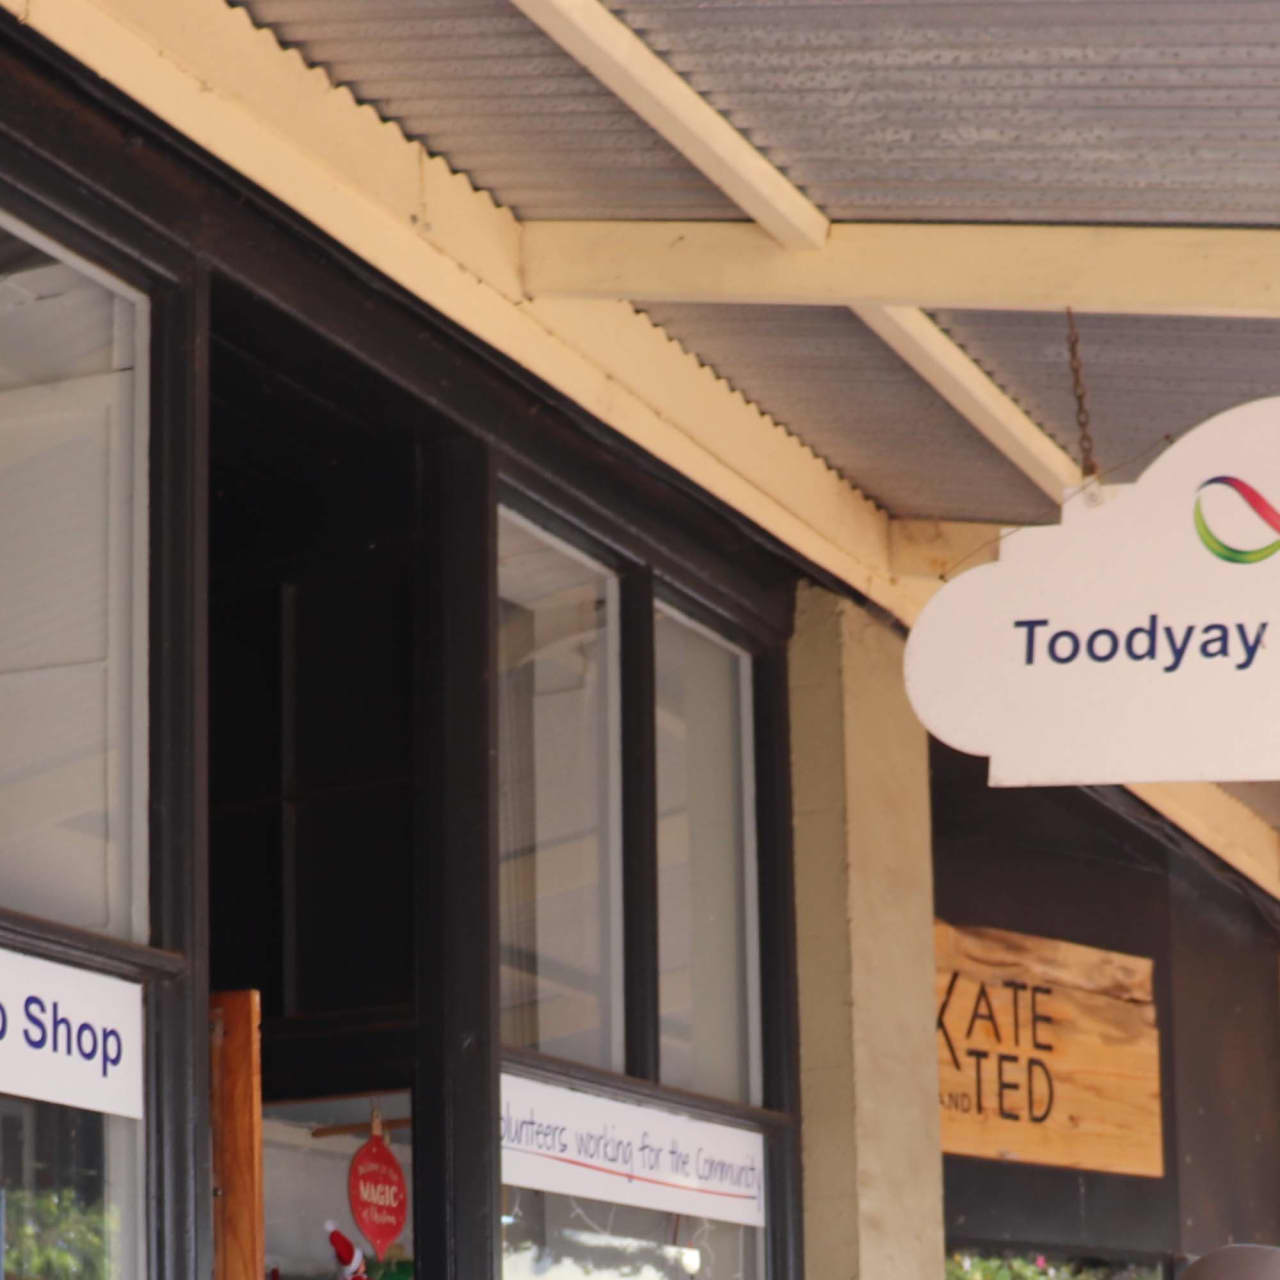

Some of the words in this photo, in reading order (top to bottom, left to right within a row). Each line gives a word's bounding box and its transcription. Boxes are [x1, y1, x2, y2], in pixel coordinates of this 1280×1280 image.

[1013, 615, 1268, 672] Toodyay
[23, 996, 123, 1077] Shop
[966, 1048, 1055, 1124] TED
[575, 1123, 634, 1183] working
[638, 1131, 661, 1170] for
[669, 1140, 690, 1177] the
